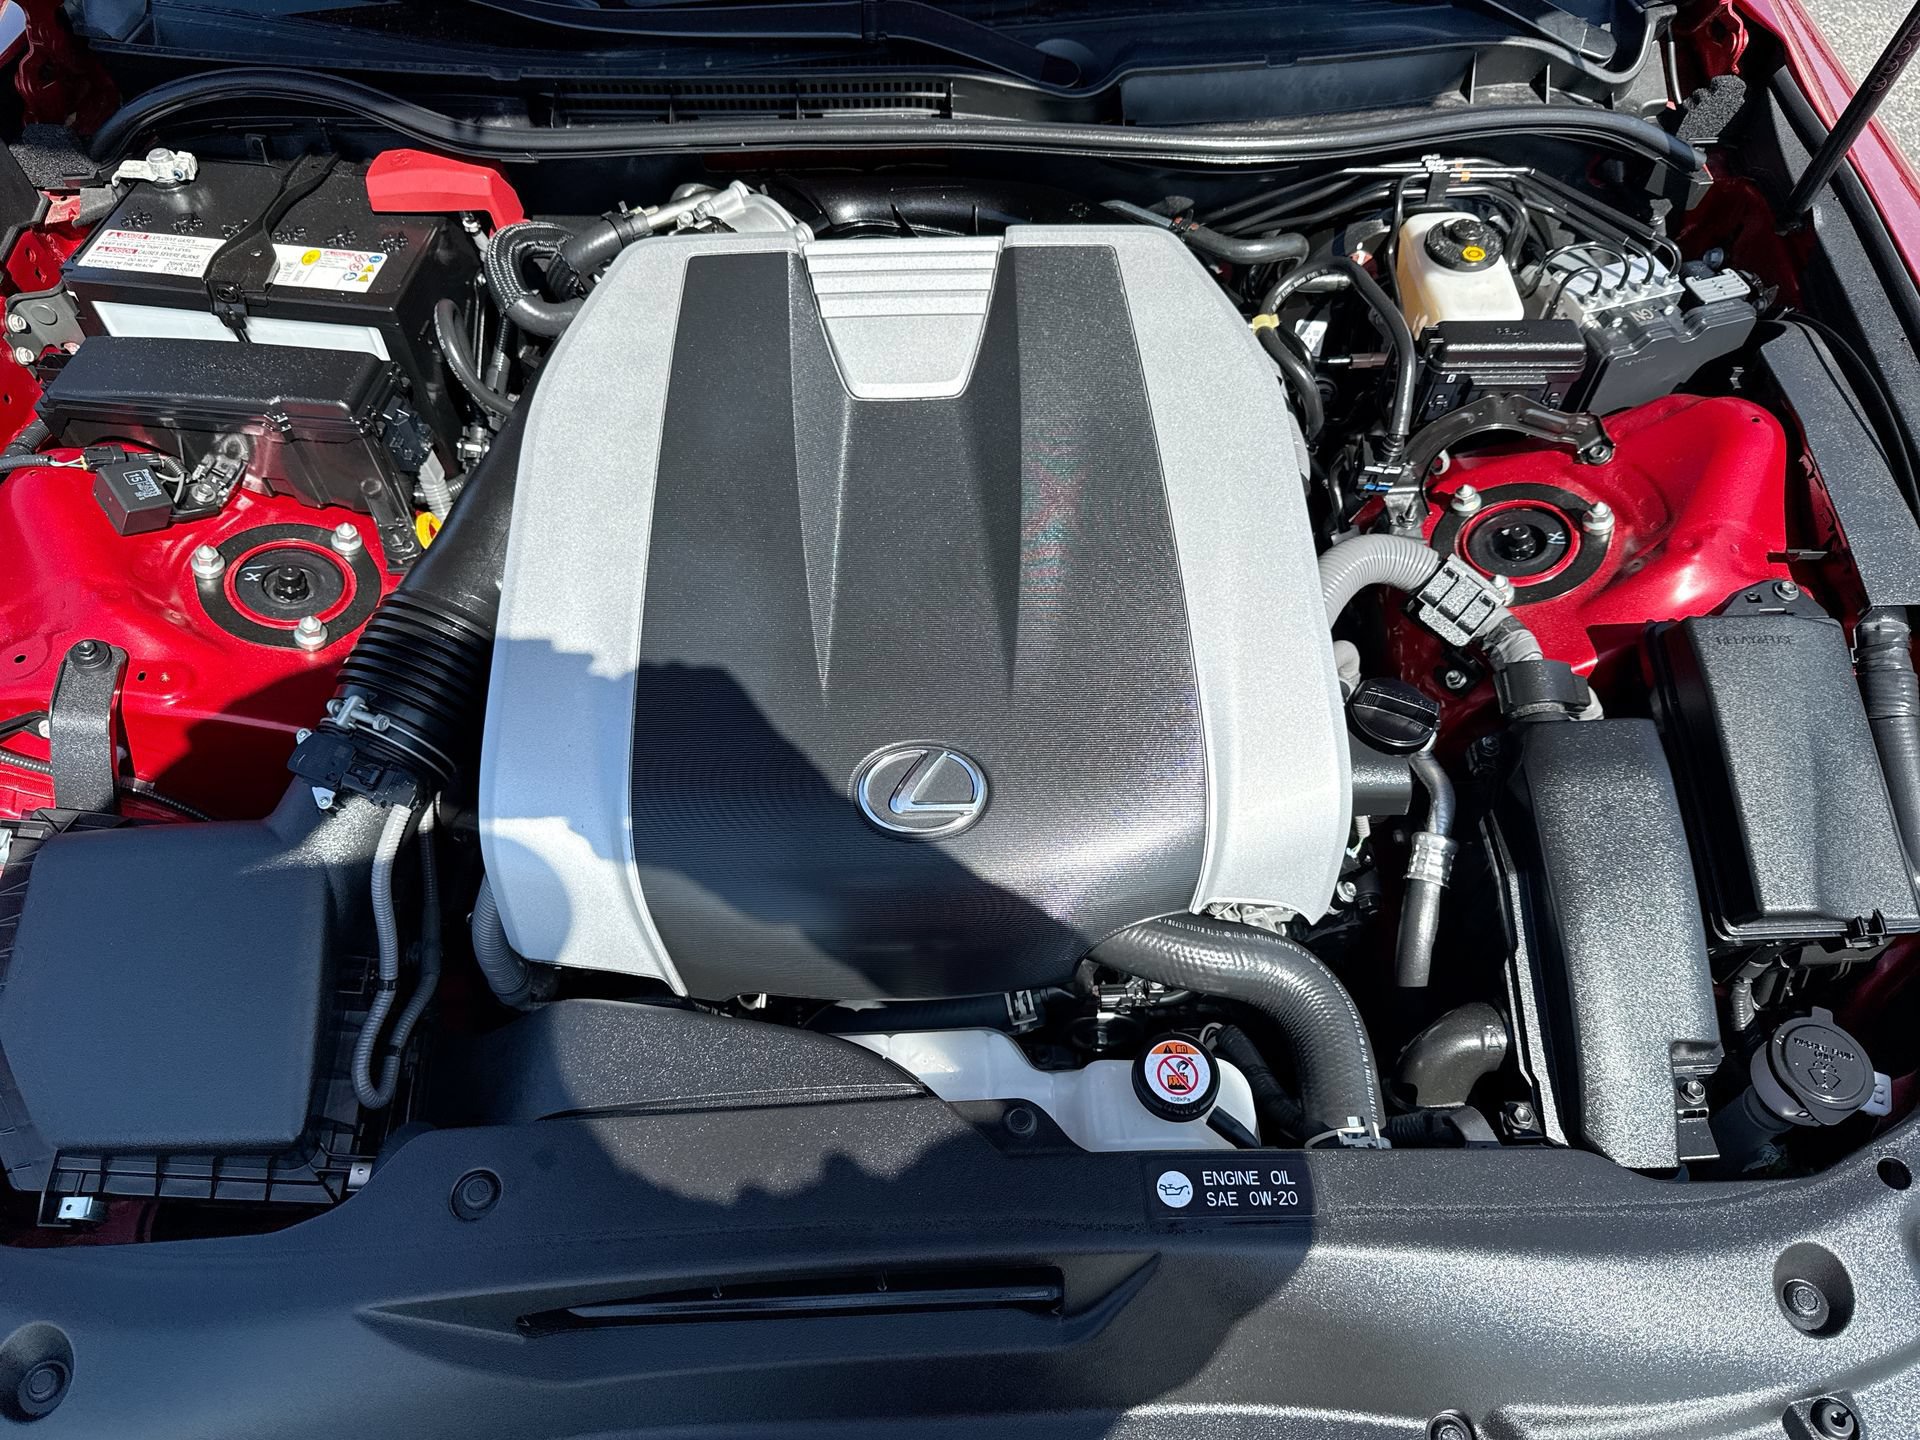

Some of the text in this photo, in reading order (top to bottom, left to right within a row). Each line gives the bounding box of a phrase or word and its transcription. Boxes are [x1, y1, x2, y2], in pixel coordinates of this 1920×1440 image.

[129, 473, 143, 483] 15
[1202, 1170, 1296, 1186] ENGINE OIL
[1206, 1190, 1298, 1207] SAE 0W-20
